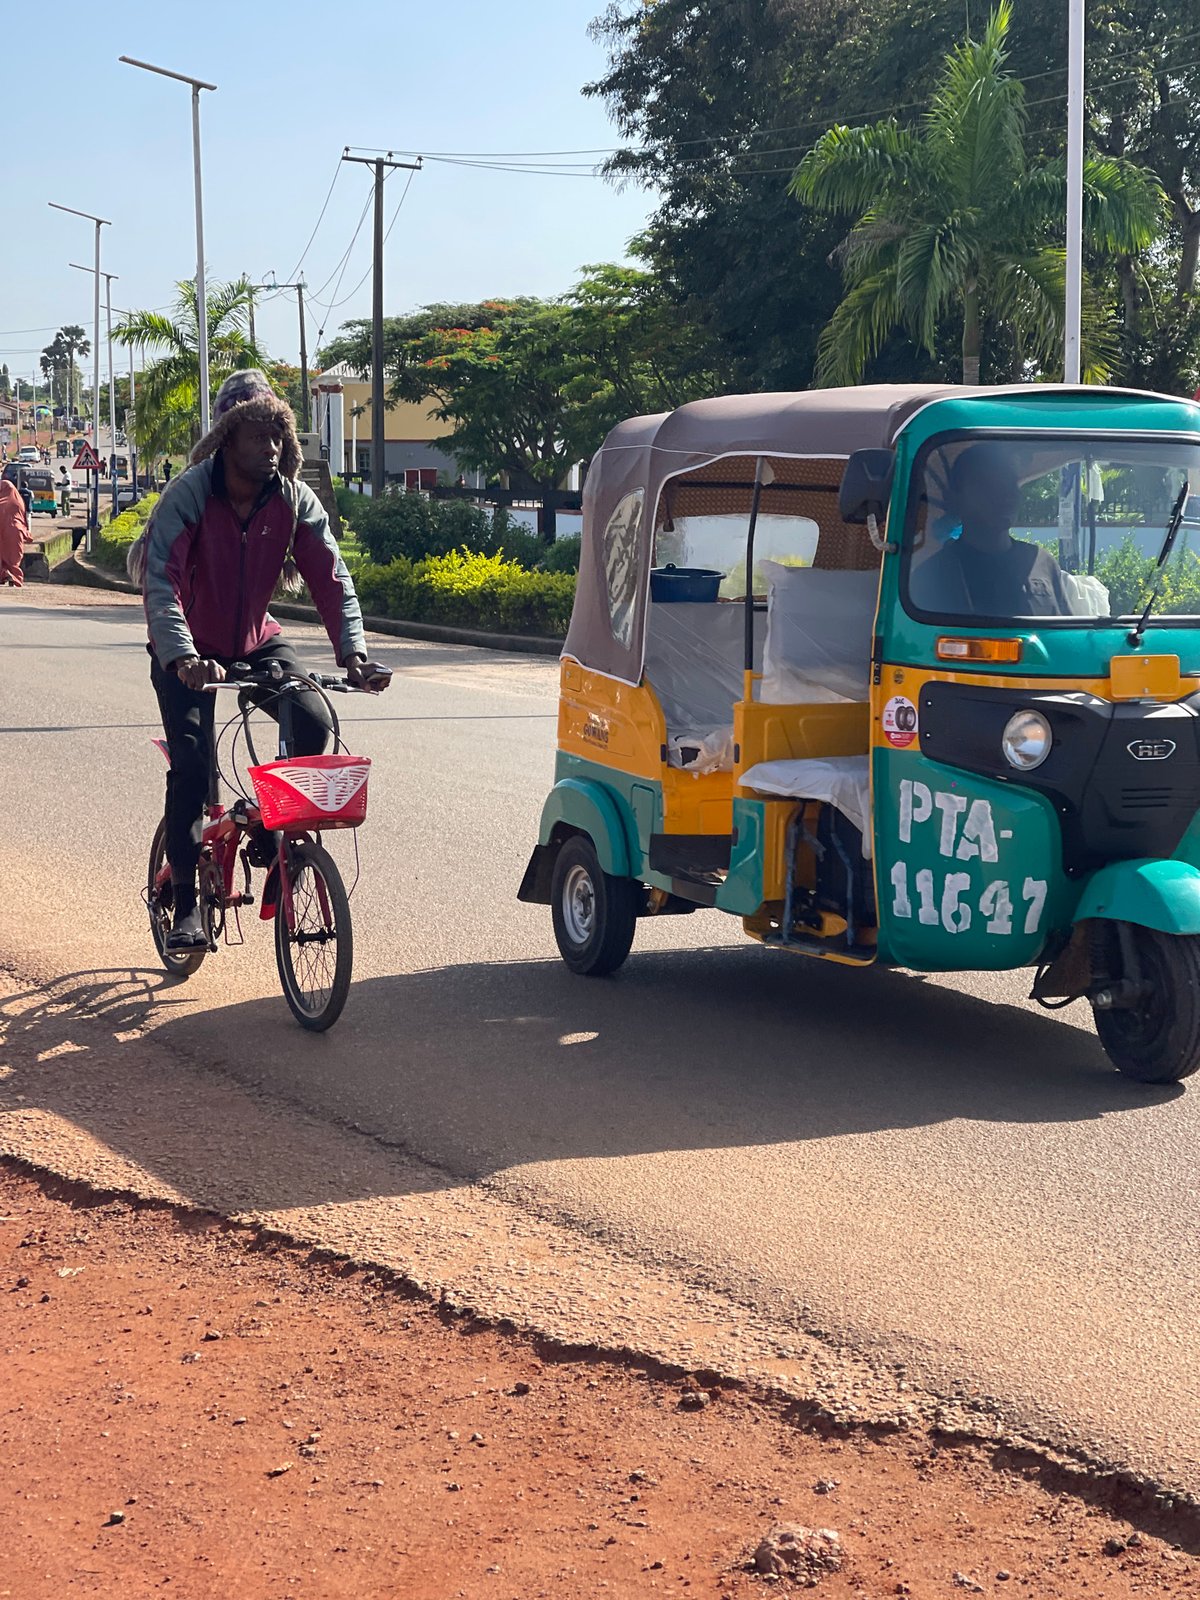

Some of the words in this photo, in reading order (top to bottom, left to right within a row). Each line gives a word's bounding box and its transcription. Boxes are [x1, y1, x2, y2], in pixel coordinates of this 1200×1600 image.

[1138, 745, 1167, 757] RE
[898, 779, 1013, 862] PTA-
[890, 861, 1048, 934] 11647
